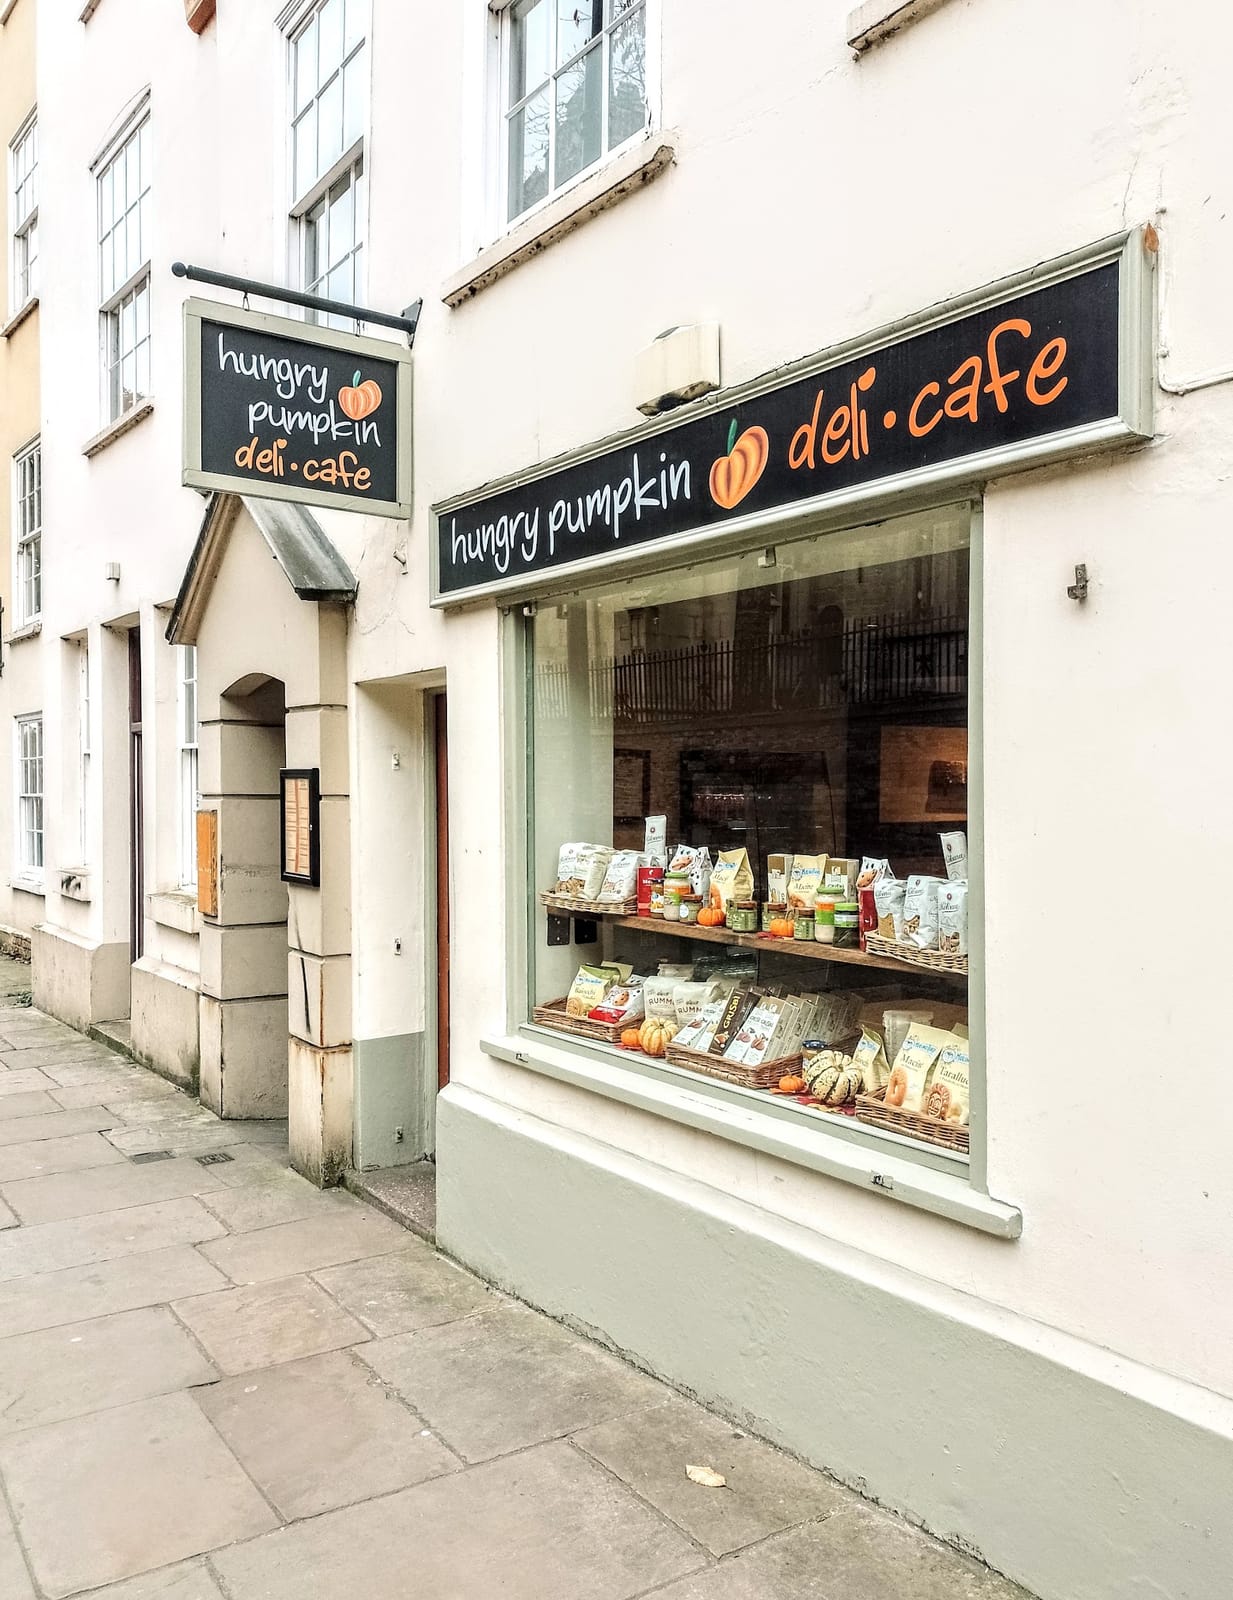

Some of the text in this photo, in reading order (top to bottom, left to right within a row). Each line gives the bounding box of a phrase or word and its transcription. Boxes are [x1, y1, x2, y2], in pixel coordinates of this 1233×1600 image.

[218, 332, 328, 403] hungry
[248, 399, 382, 448] pumpkin
[451, 318, 1068, 573] hungry pumpkin deli cafe
[234, 436, 372, 490] deli cafe
[648, 997, 675, 1006] RUMM
[677, 1006, 702, 1014] RUMM
